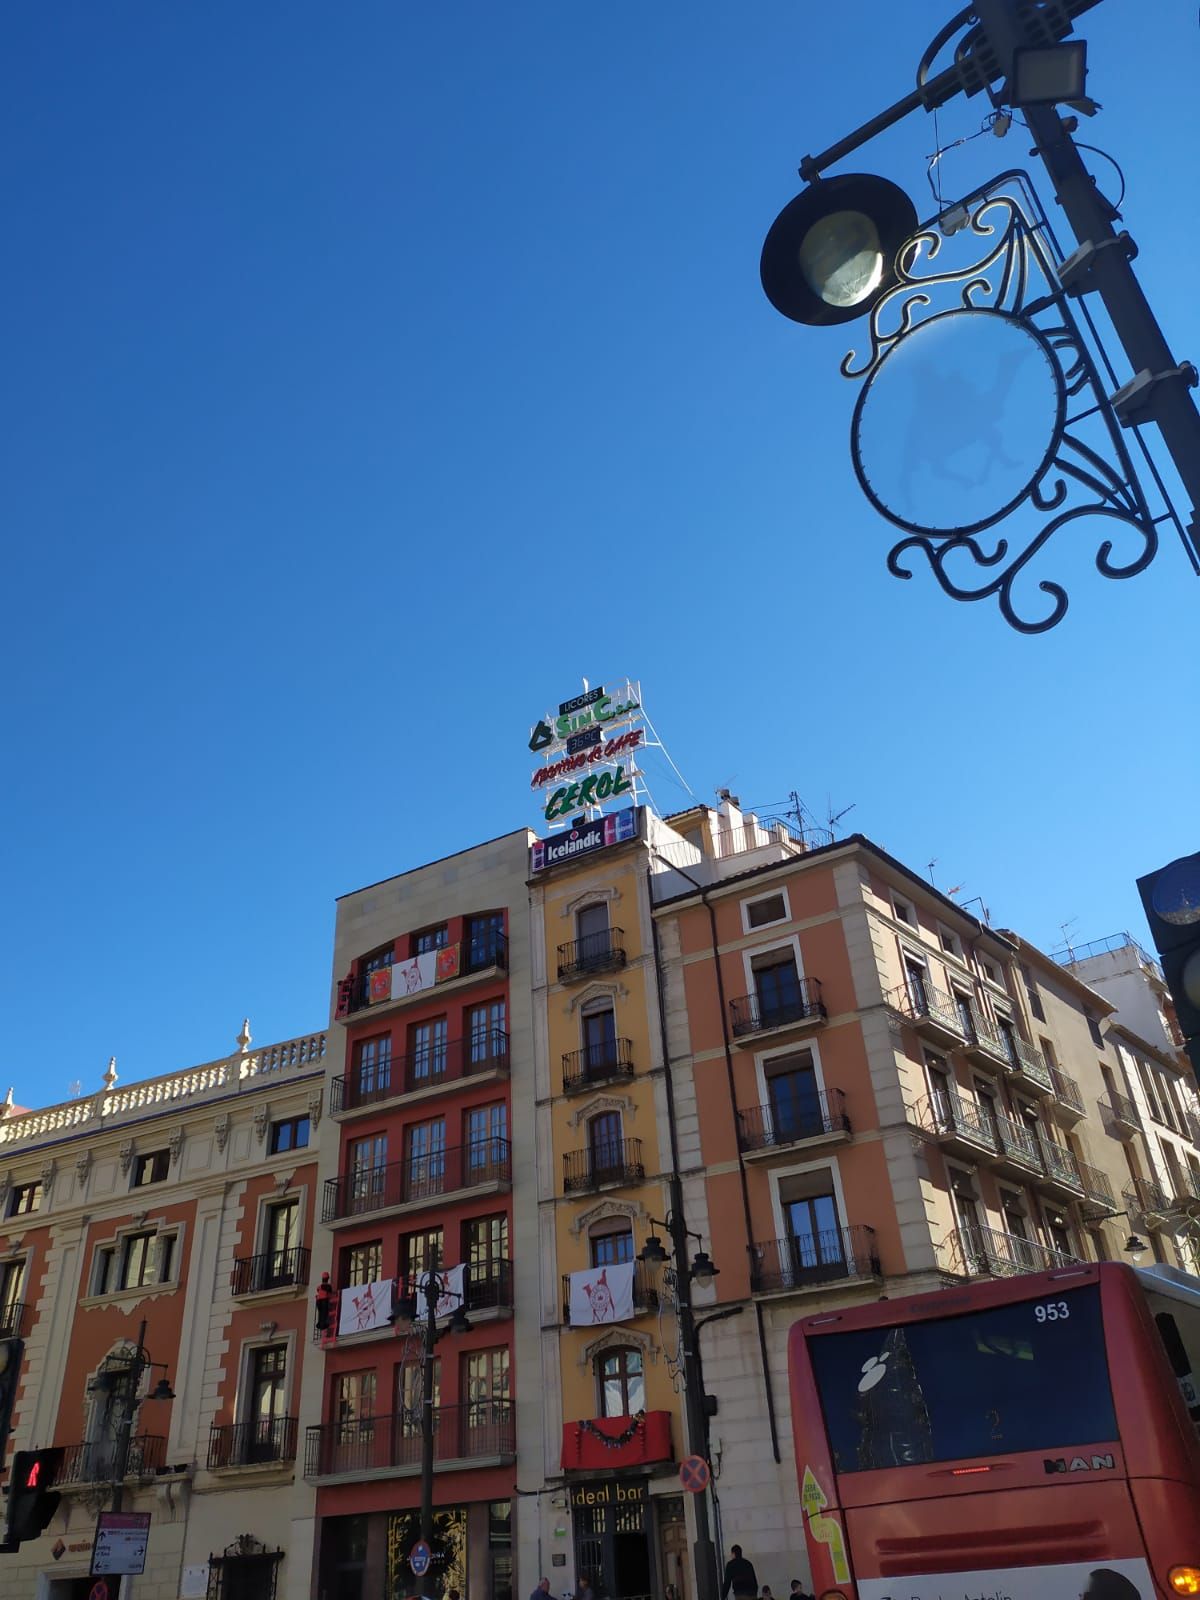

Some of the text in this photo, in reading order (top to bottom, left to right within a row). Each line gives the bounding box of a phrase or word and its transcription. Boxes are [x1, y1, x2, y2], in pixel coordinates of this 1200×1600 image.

[563, 690, 599, 712] LICORES
[545, 766, 631, 820] CEROL
[547, 831, 601, 861] Icelandic
[1034, 1301, 1070, 1323] 953
[1043, 1454, 1115, 1474] MAN
[572, 1482, 643, 1505] ideal bar
